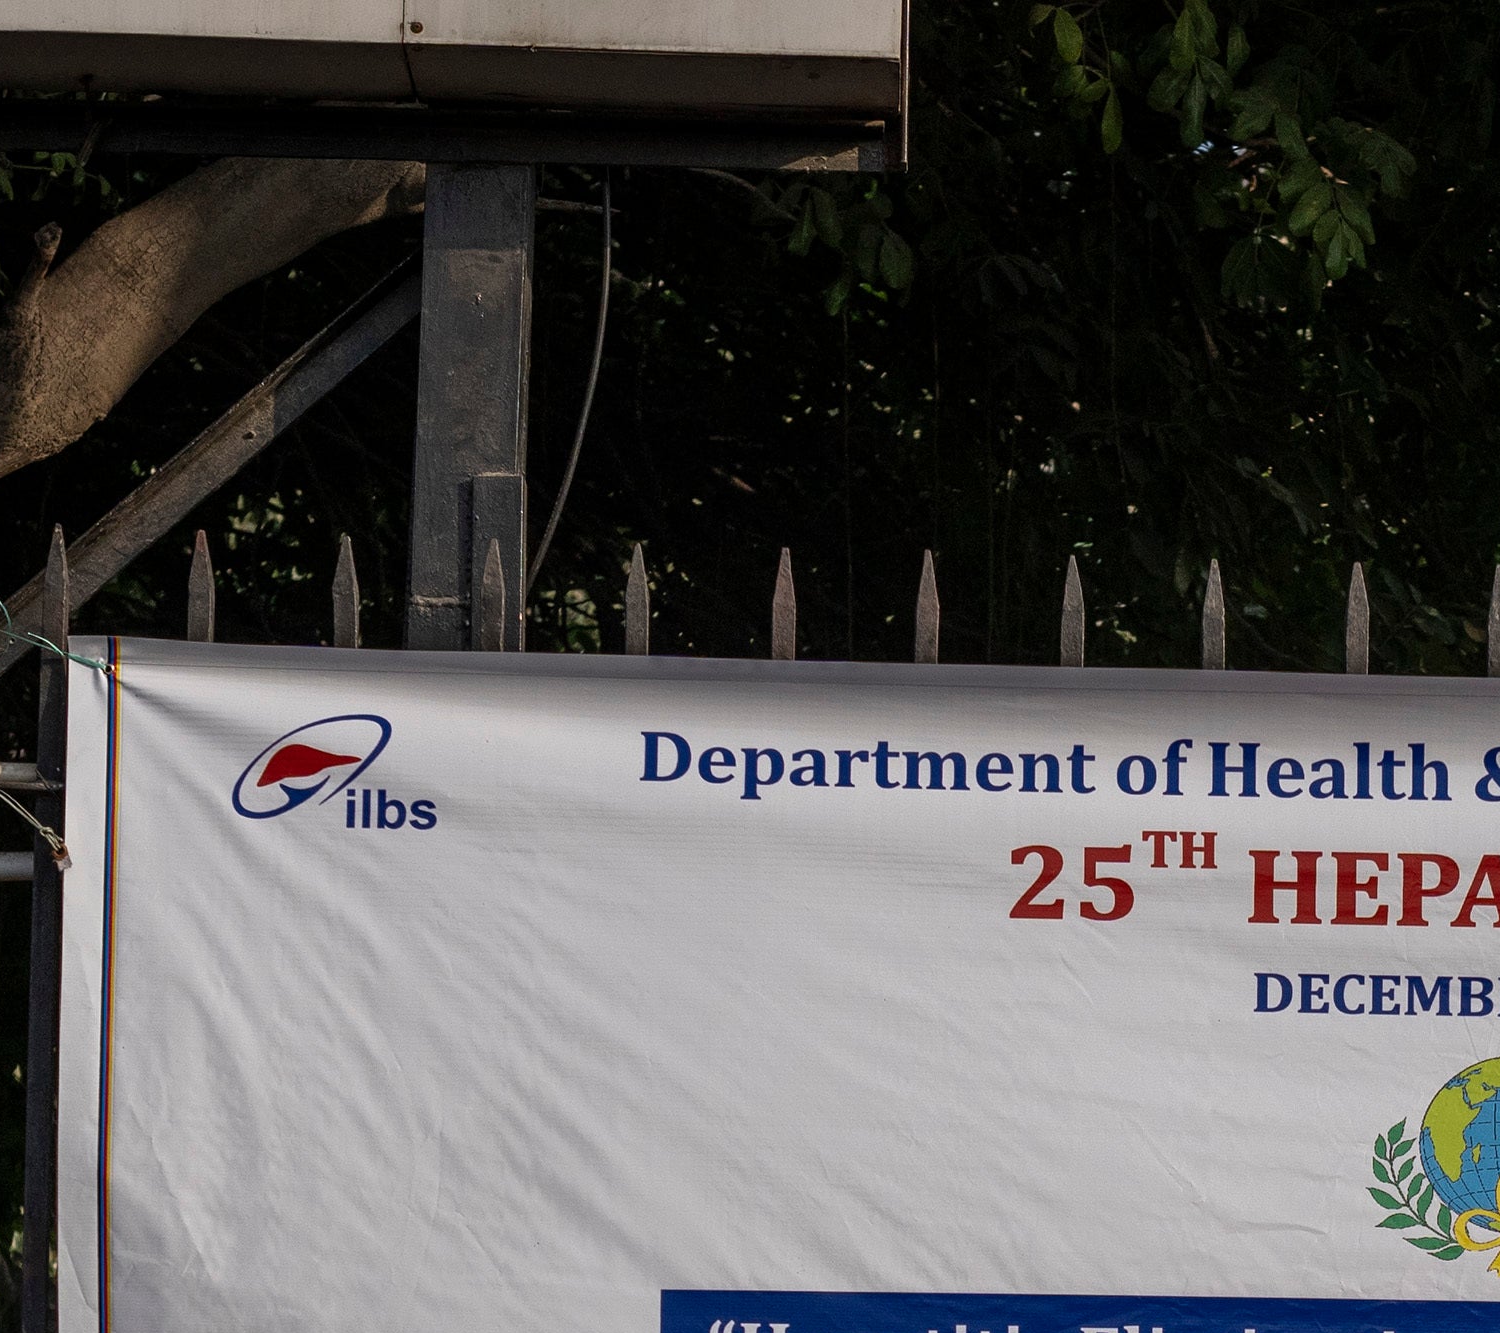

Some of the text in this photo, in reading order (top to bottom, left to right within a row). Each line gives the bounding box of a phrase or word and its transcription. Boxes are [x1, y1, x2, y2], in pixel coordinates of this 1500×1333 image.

[640, 730, 1092, 800] Department
[1117, 738, 1194, 797] of
[1207, 743, 1451, 802] Health
[344, 786, 437, 831] ilbs
